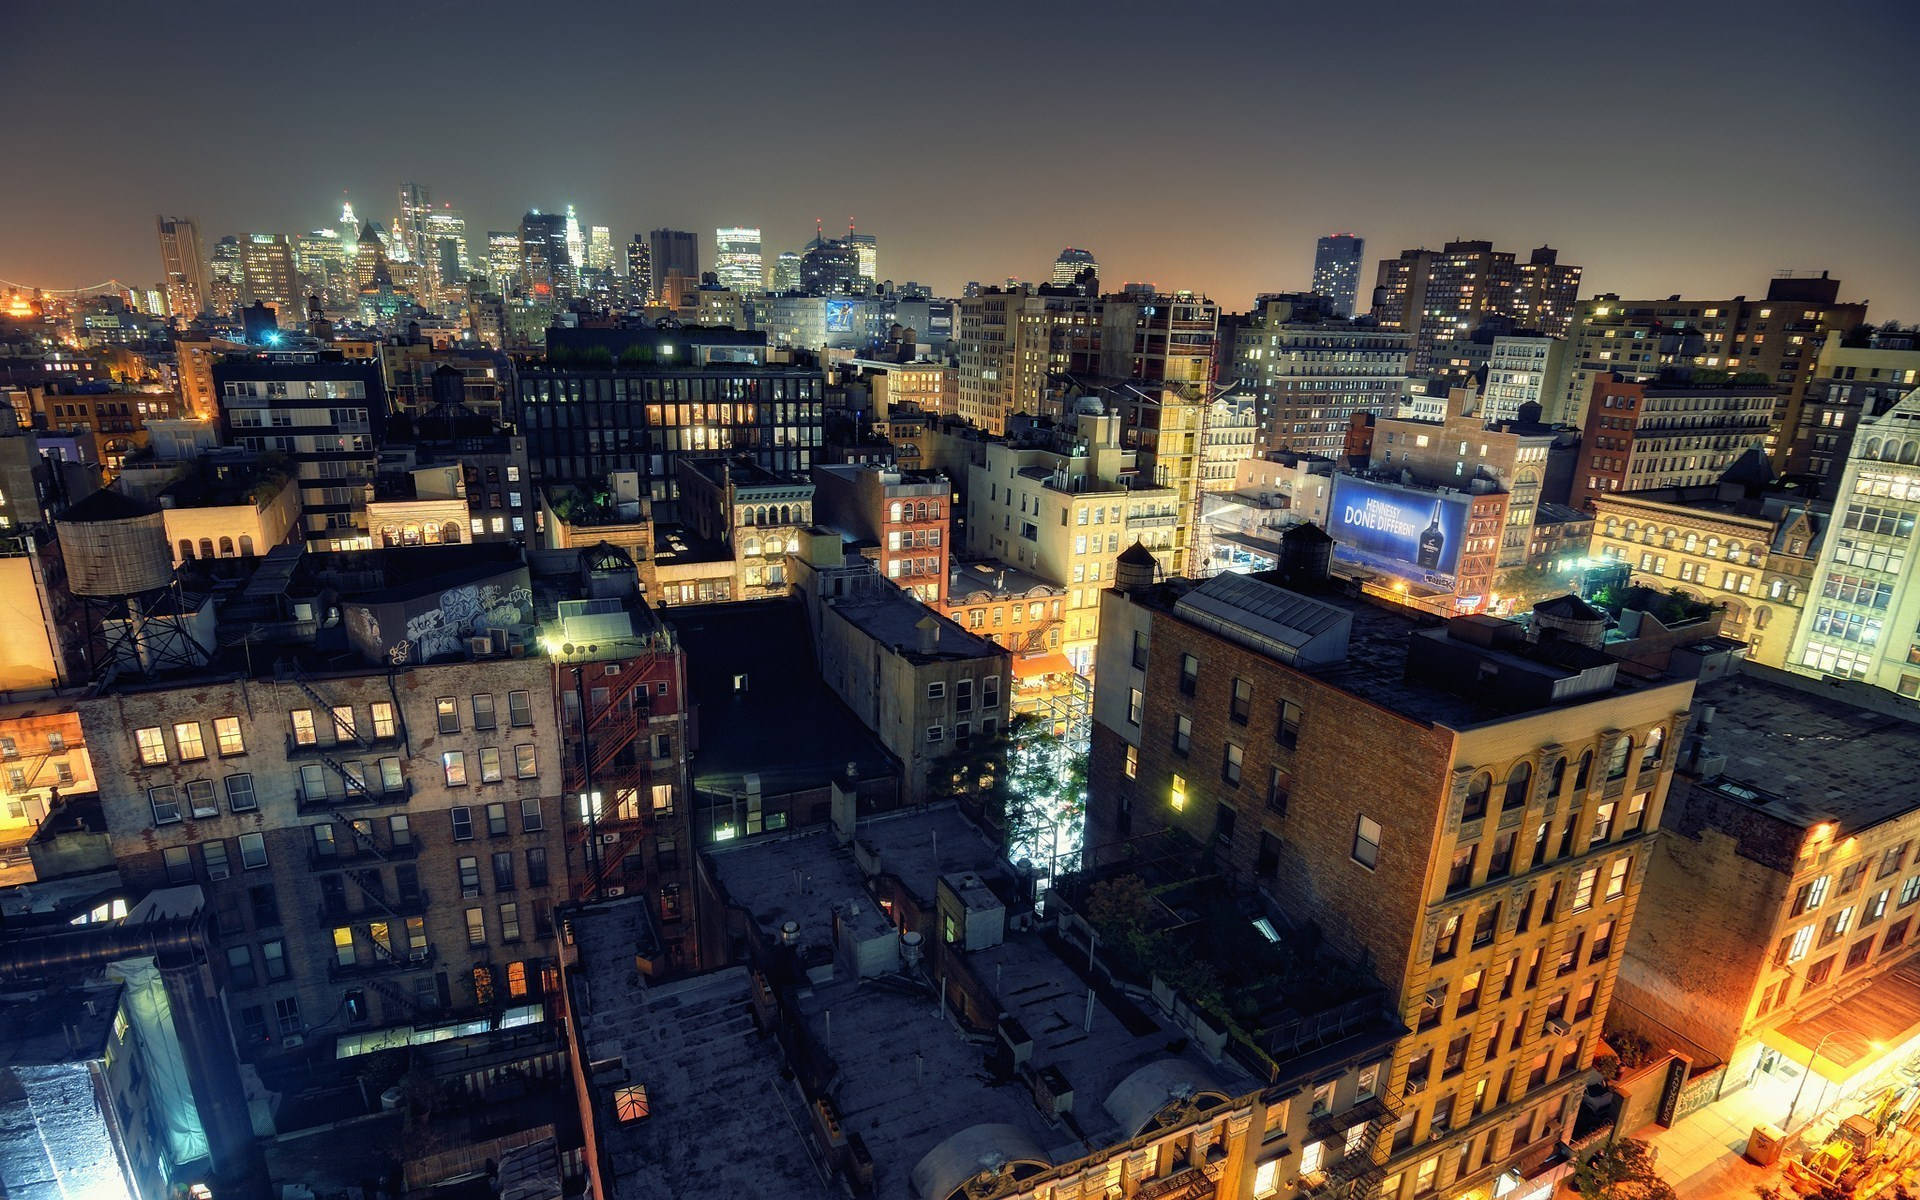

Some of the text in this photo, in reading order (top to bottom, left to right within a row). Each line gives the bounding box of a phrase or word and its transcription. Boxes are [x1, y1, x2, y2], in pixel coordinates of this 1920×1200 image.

[1344, 505, 1415, 536] DONE DIFFERENT
[1366, 497, 1401, 519] HENNESSY
